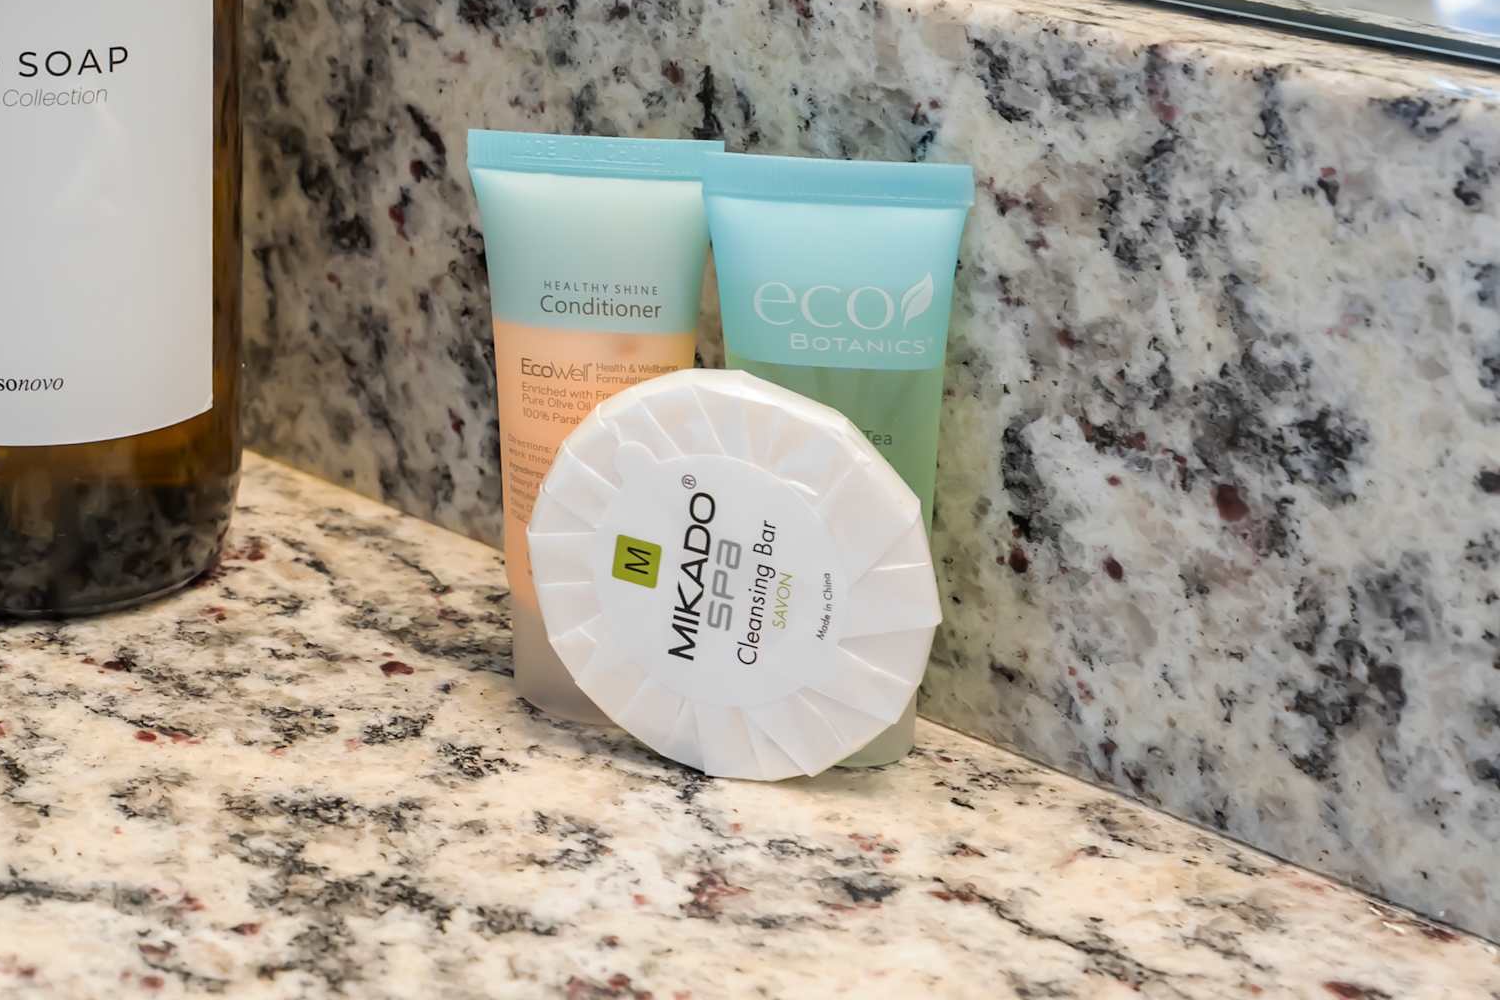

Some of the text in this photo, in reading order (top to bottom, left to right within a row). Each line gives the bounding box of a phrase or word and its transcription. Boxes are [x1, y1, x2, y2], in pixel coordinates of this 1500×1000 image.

[18, 45, 129, 78] SOAP
[2, 86, 109, 107] Collection
[543, 280, 659, 296] HEALTHY SHINE
[540, 294, 662, 319] Conditioner
[753, 280, 896, 330] eco
[522, 381, 566, 398] Enriched
[569, 387, 593, 399] with
[522, 392, 545, 406] Pure
[547, 395, 574, 410] Olive
[523, 407, 550, 421] 100%
[862, 429, 893, 446] Tea
[624, 546, 652, 575] M
[737, 519, 777, 665] Cleansing Bar
[772, 571, 794, 630] SAVON
[816, 572, 833, 641] Made in China
